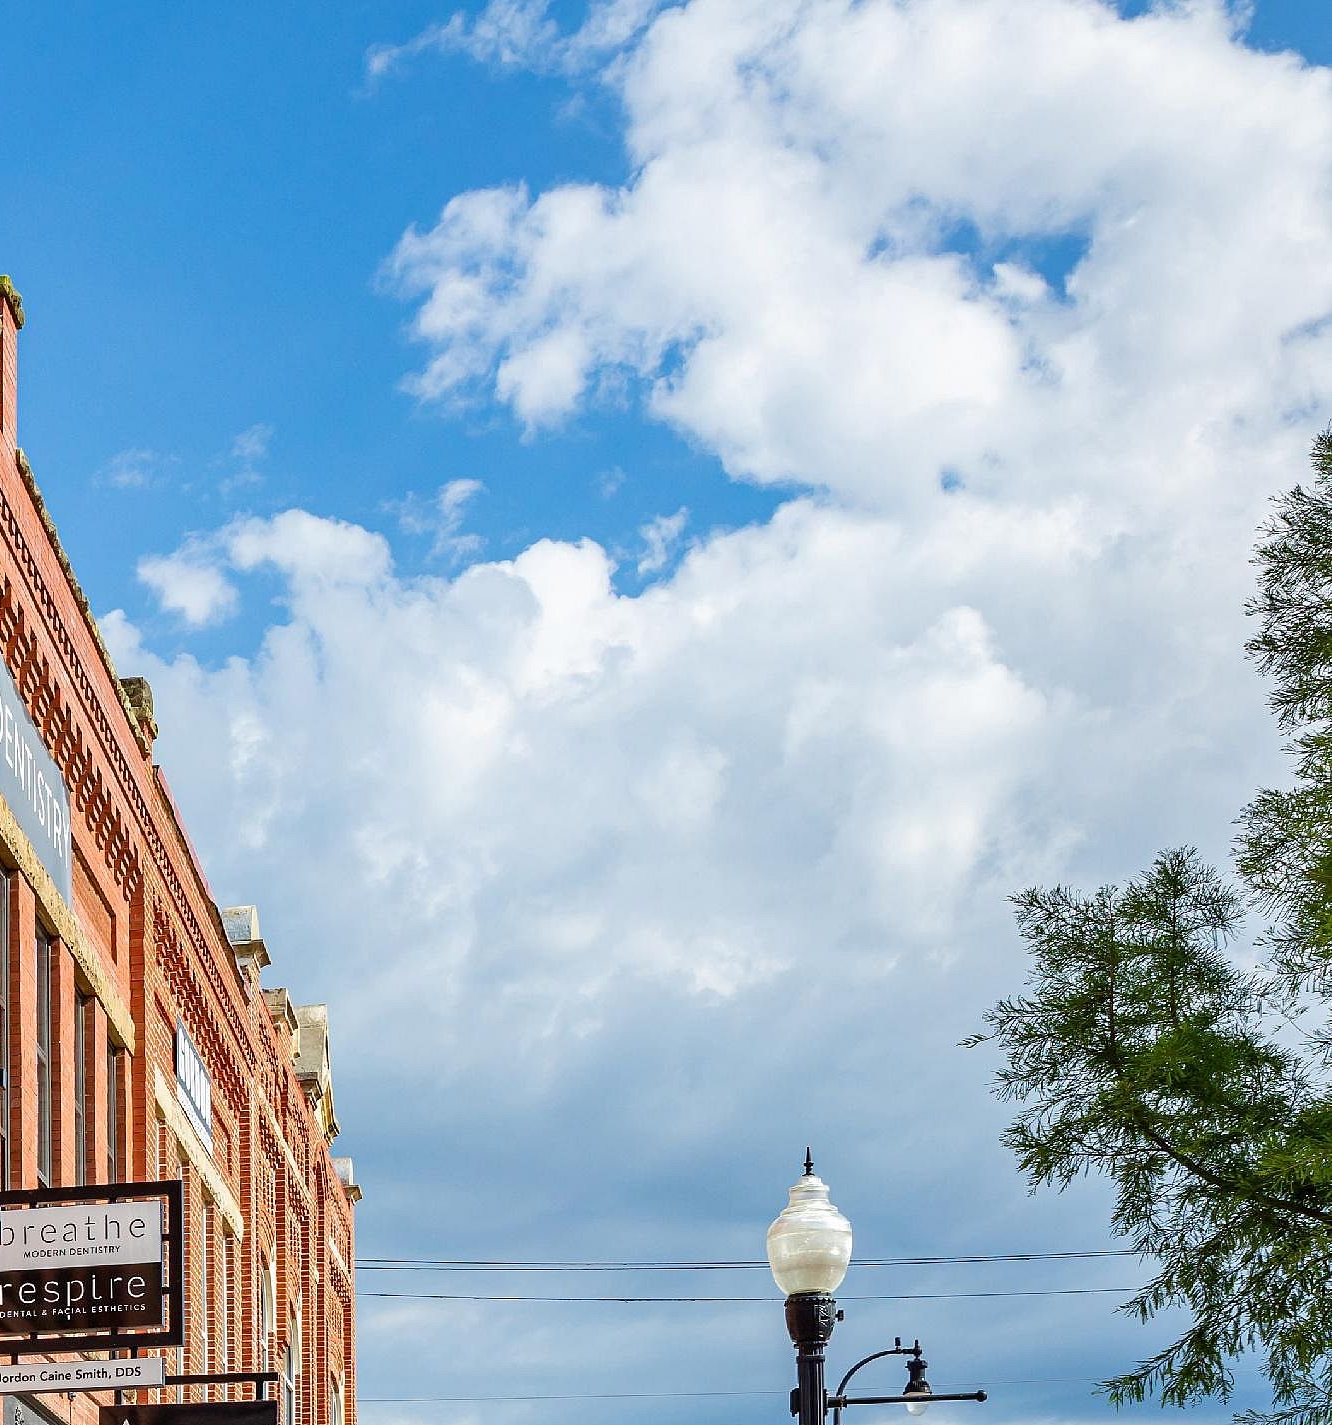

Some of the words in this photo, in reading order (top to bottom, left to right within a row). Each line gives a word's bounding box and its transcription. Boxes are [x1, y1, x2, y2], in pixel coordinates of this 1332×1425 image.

[0, 1214, 146, 1246] breathe
[23, 1248, 66, 1259] MODERN
[69, 1245, 121, 1256] DENTISTRY
[0, 1274, 146, 1311] respire
[0, 1309, 38, 1319] DENTAL
[52, 1307, 87, 1316] FACIAL
[91, 1303, 146, 1313] ESTHETICS
[40, 1370, 72, 1381] Caine
[75, 1368, 112, 1380] Smith,
[115, 1366, 142, 1378] DDS
